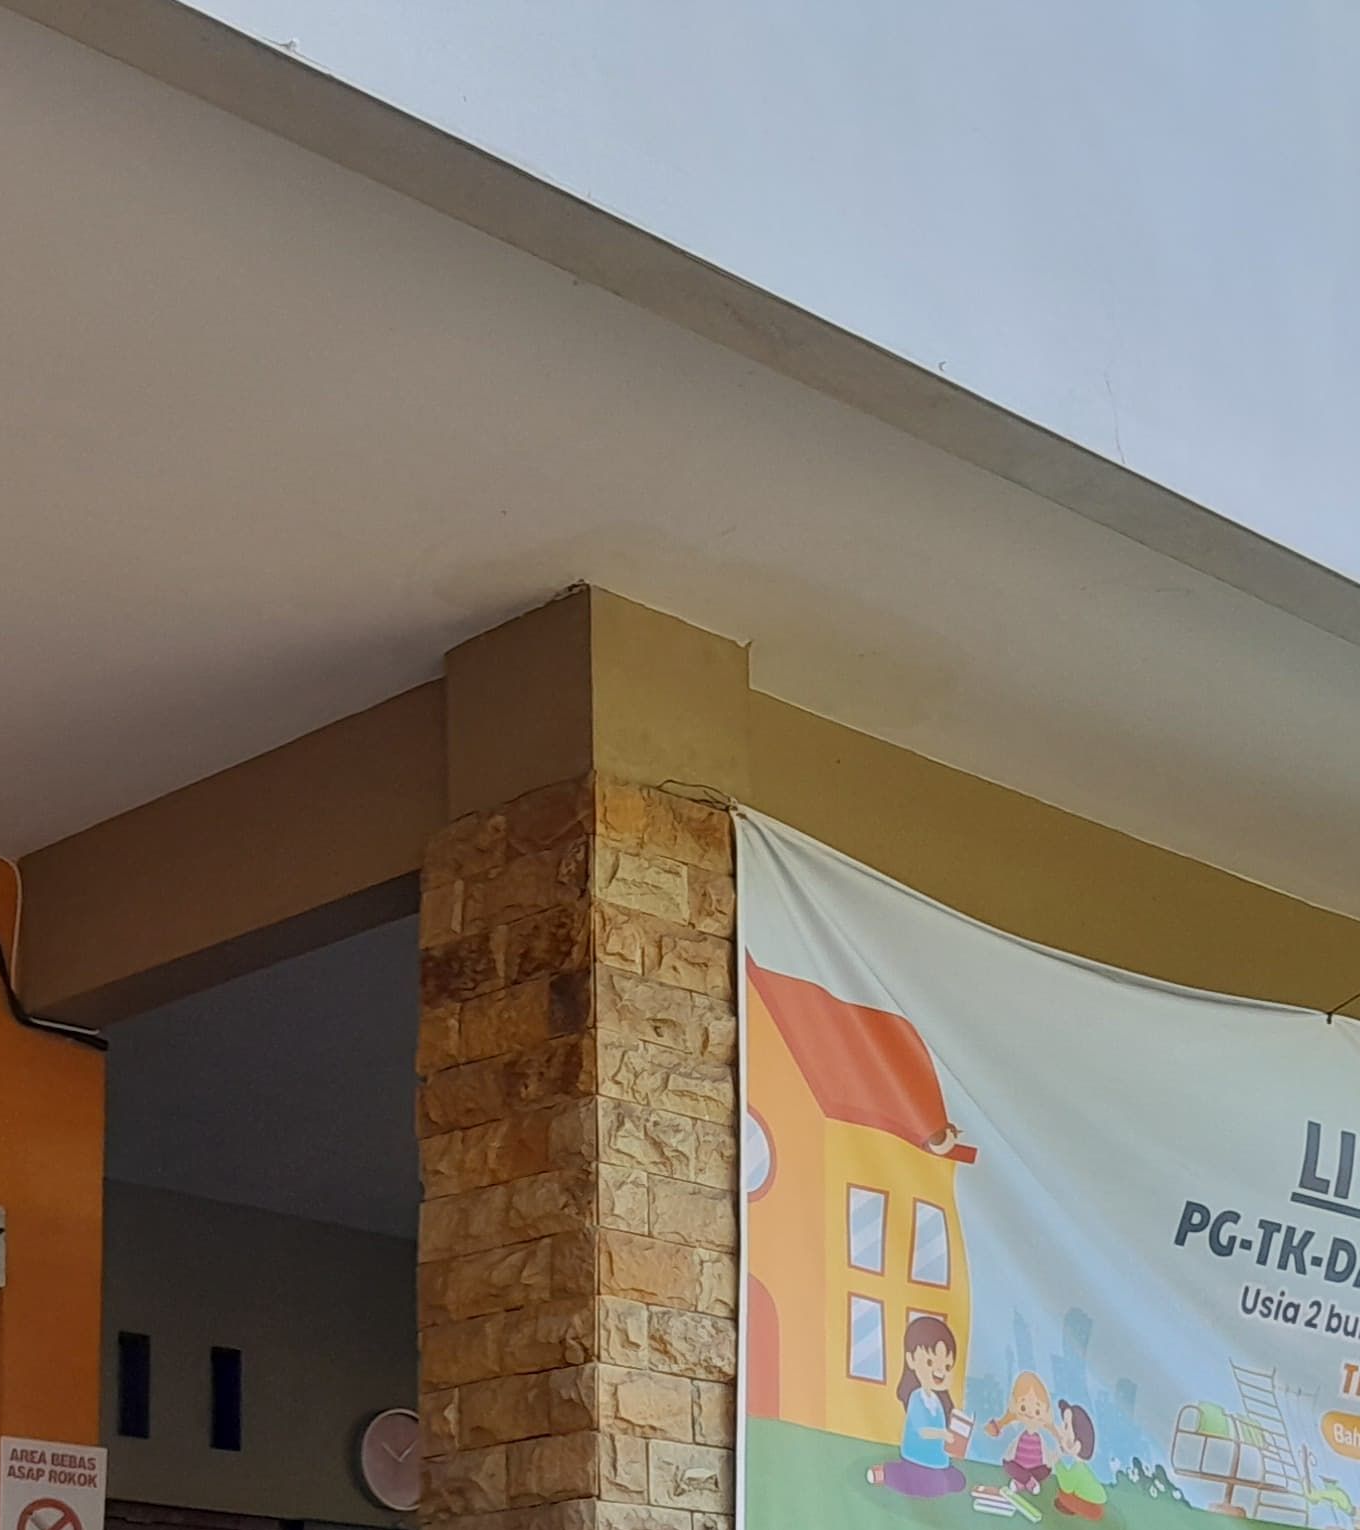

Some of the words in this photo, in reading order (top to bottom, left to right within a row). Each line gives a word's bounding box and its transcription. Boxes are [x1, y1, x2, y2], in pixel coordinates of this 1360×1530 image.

[1240, 1286, 1300, 1324] Usia
[1304, 1300, 1323, 1328] 2
[9, 1448, 47, 1465] AREA
[51, 1452, 97, 1471] BEBAS
[7, 1465, 46, 1482] ASAP
[48, 1470, 98, 1488] ROKOK
